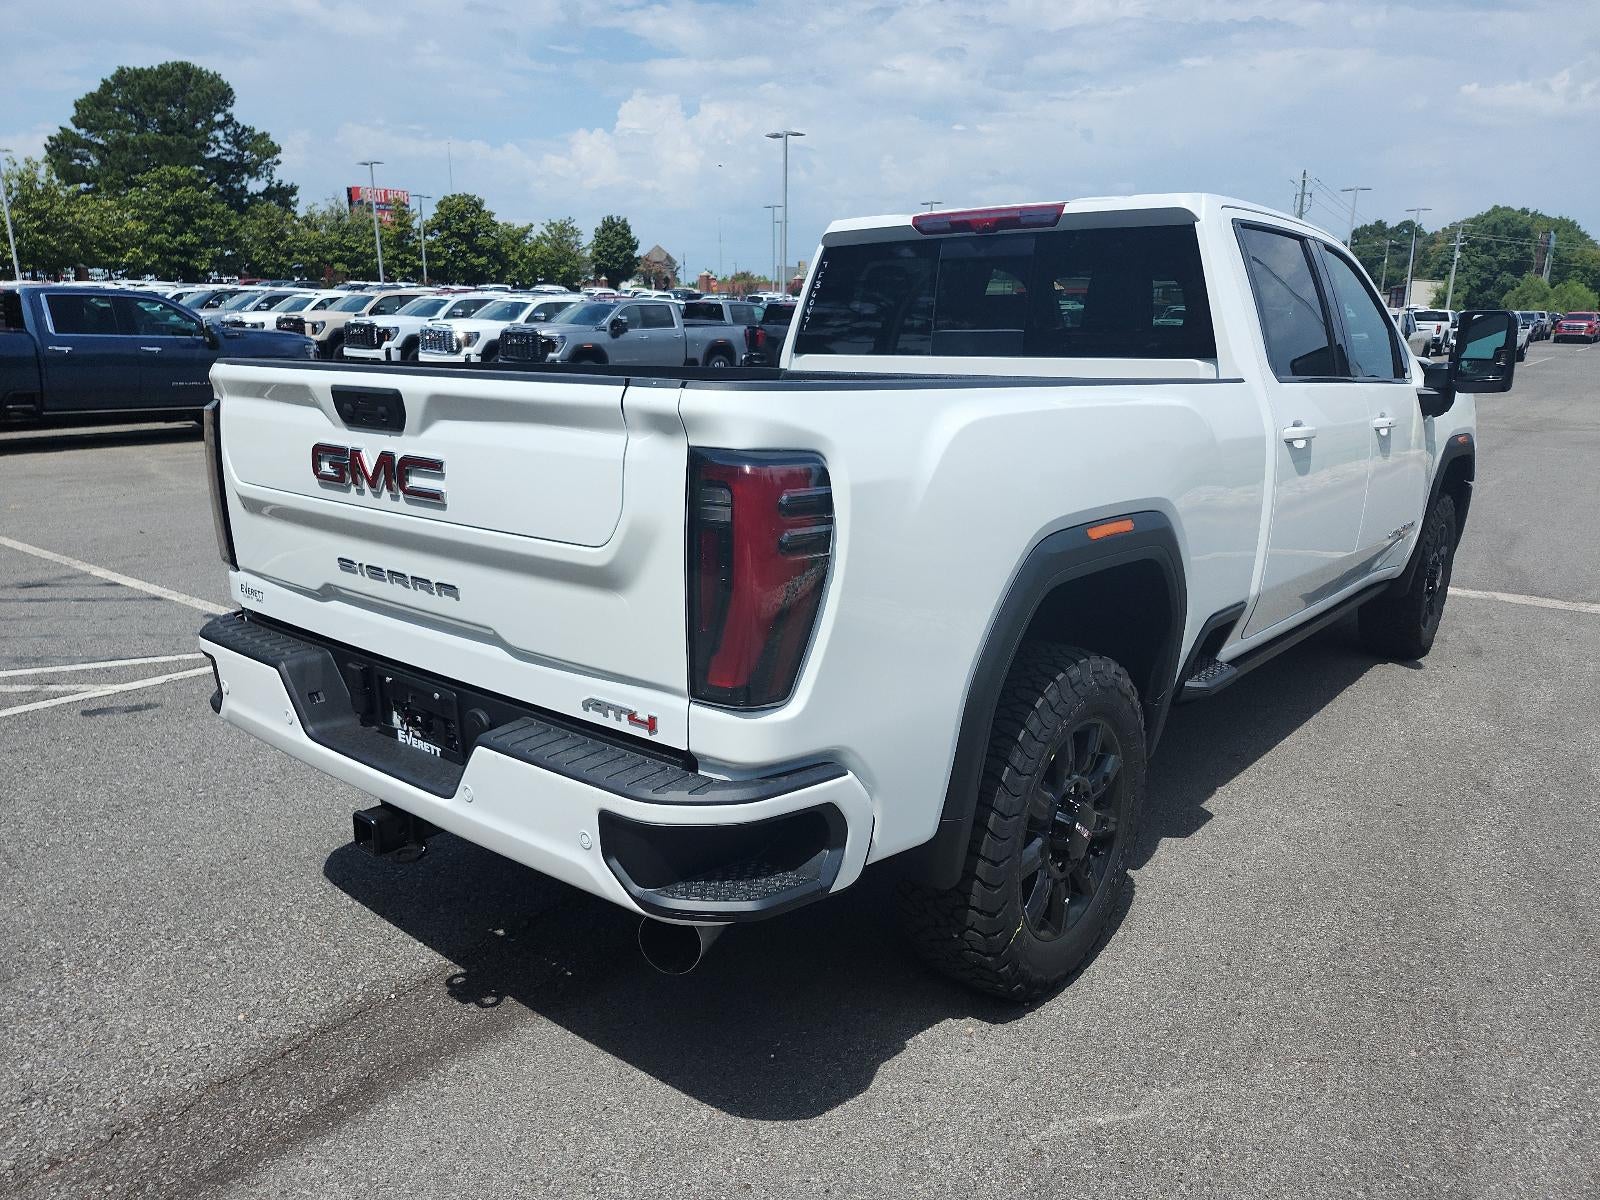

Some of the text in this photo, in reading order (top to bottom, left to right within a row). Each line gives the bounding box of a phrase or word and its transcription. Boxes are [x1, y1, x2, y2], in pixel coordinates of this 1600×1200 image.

[311, 441, 447, 506] GMC
[337, 556, 460, 601] SIERRA
[581, 697, 658, 736] AT4
[397, 729, 442, 758] EVERETT
